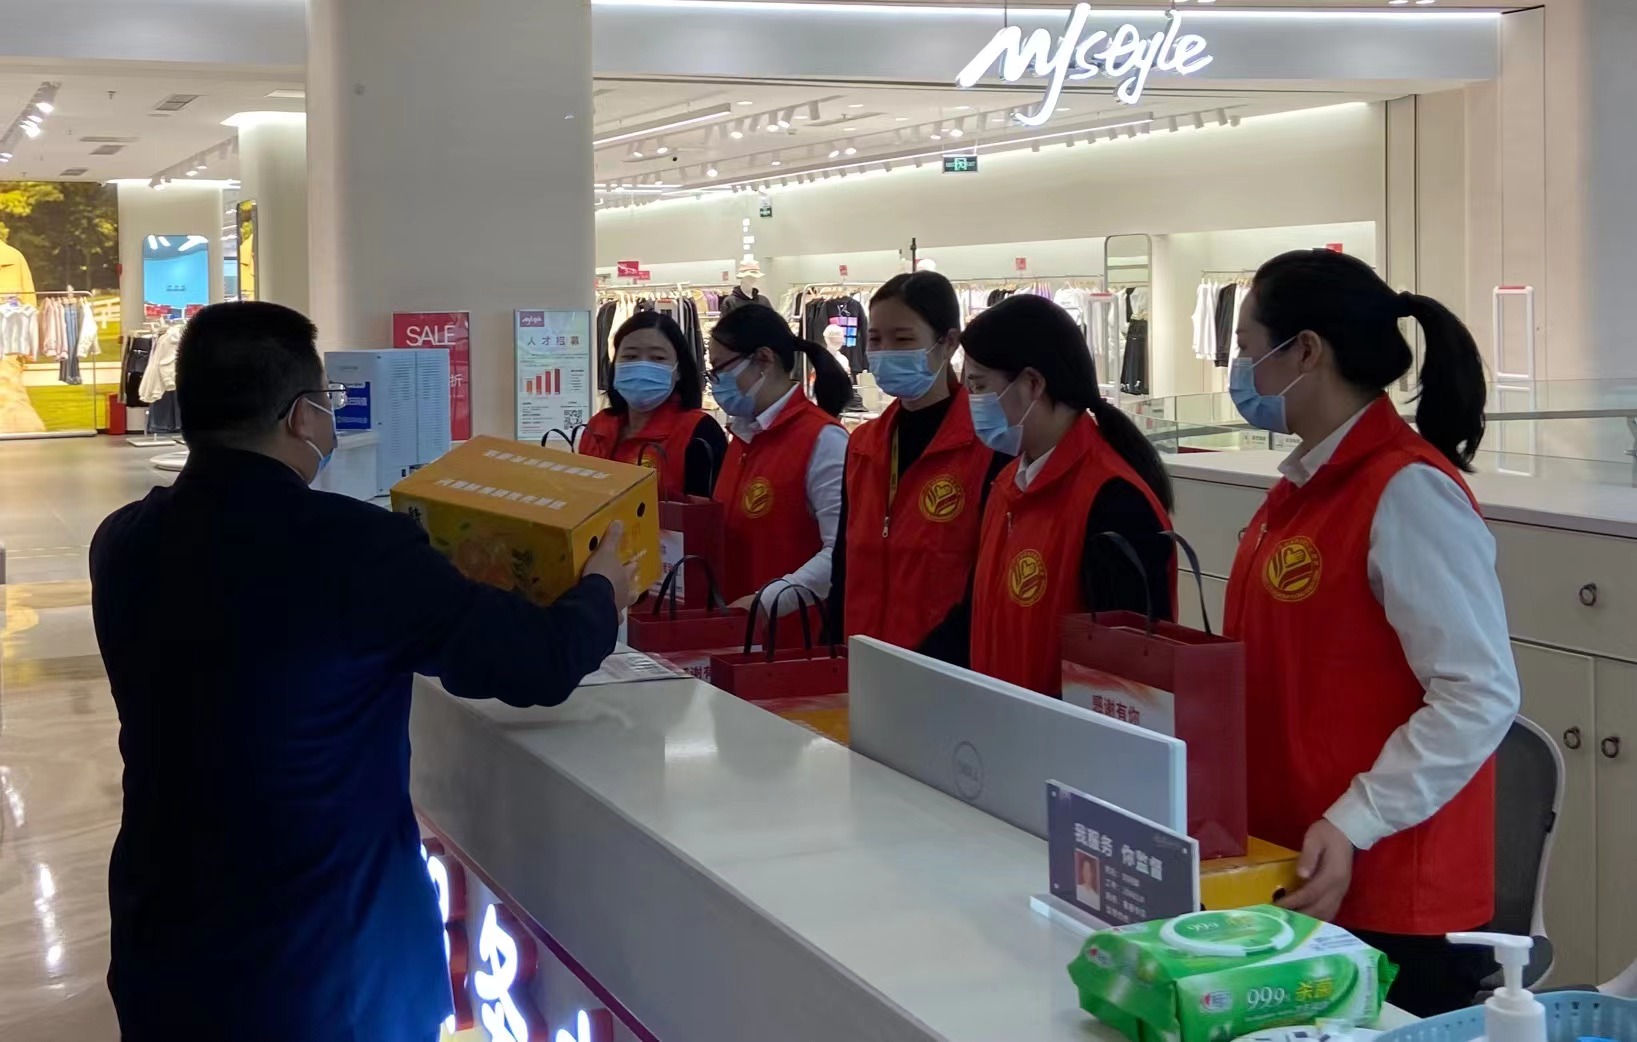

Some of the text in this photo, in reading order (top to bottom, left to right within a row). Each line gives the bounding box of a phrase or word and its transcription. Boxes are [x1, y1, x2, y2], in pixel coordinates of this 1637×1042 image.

[406, 325, 456, 346] SALE
[1074, 823, 1113, 857] 我服务
[1121, 844, 1163, 881] 你监督
